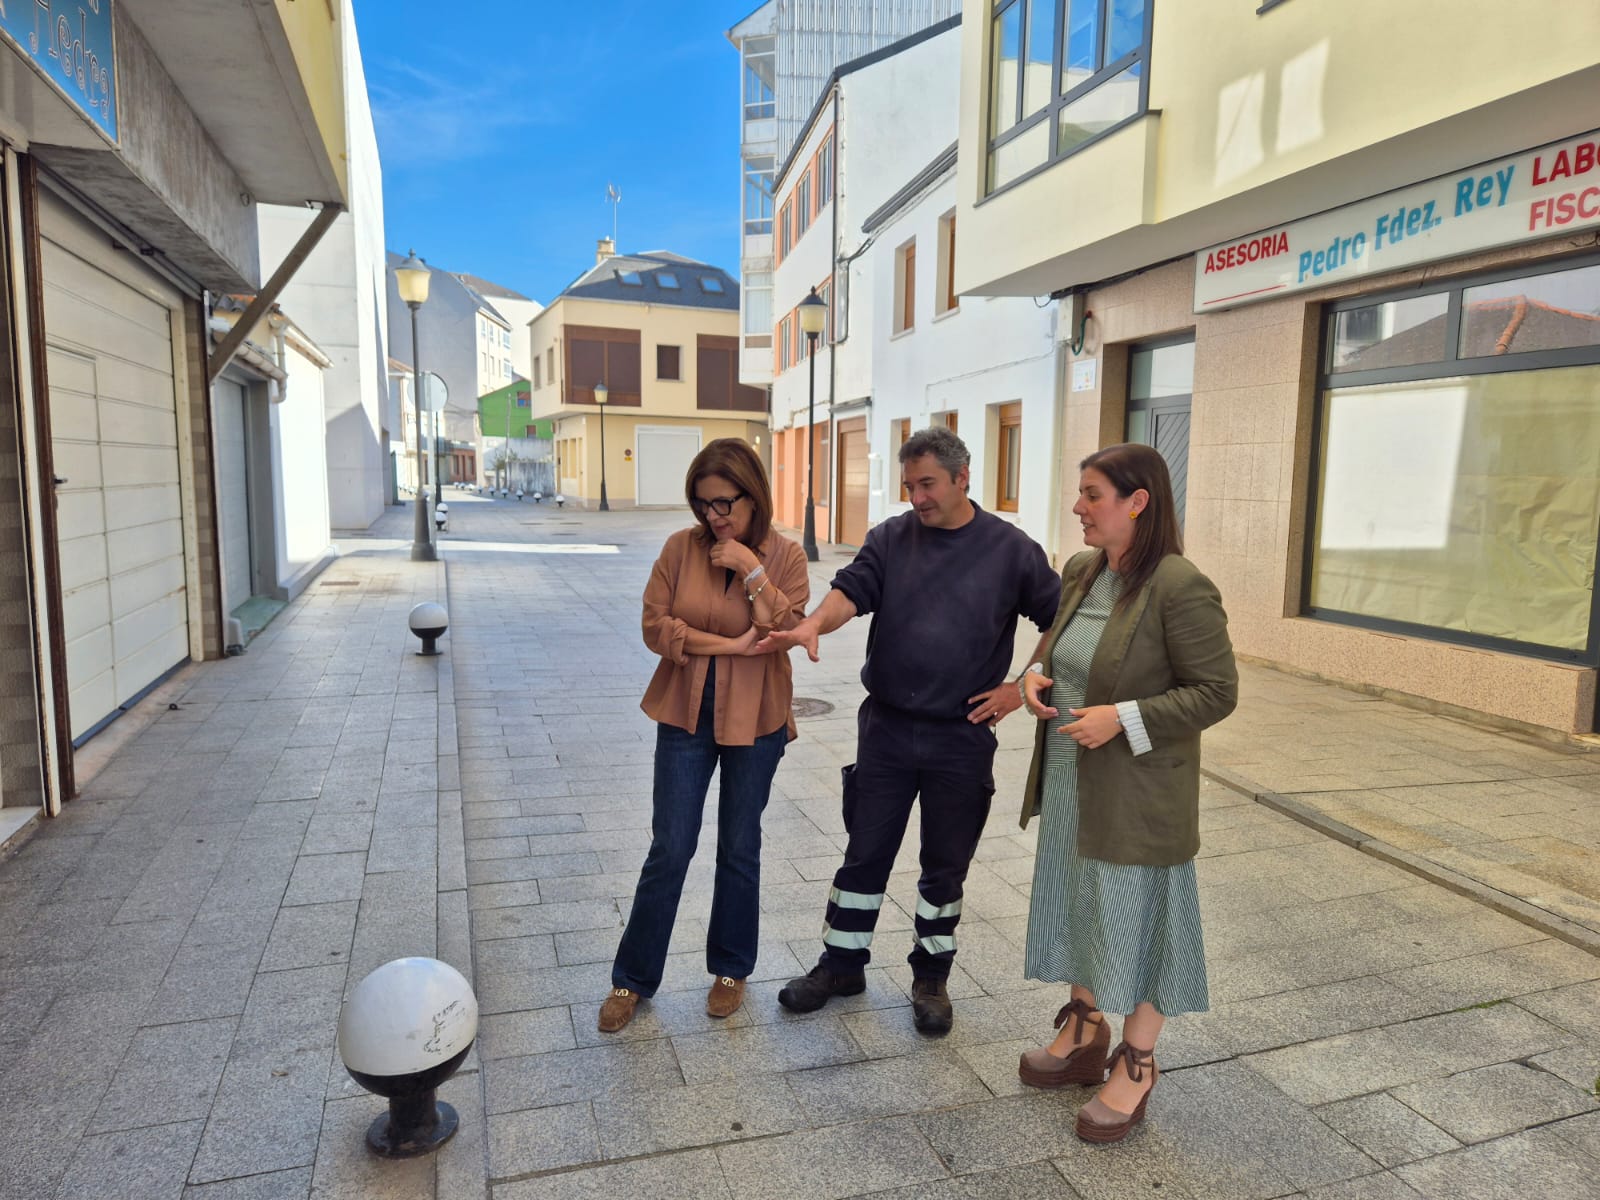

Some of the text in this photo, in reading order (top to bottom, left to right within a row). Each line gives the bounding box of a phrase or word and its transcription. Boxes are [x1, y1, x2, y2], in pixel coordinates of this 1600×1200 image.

[1532, 142, 1600, 187] LAB
[1298, 165, 1515, 283] Pedro Fdez. Rey
[1529, 187, 1600, 231] FISC
[1205, 231, 1289, 275] ASESORIA
